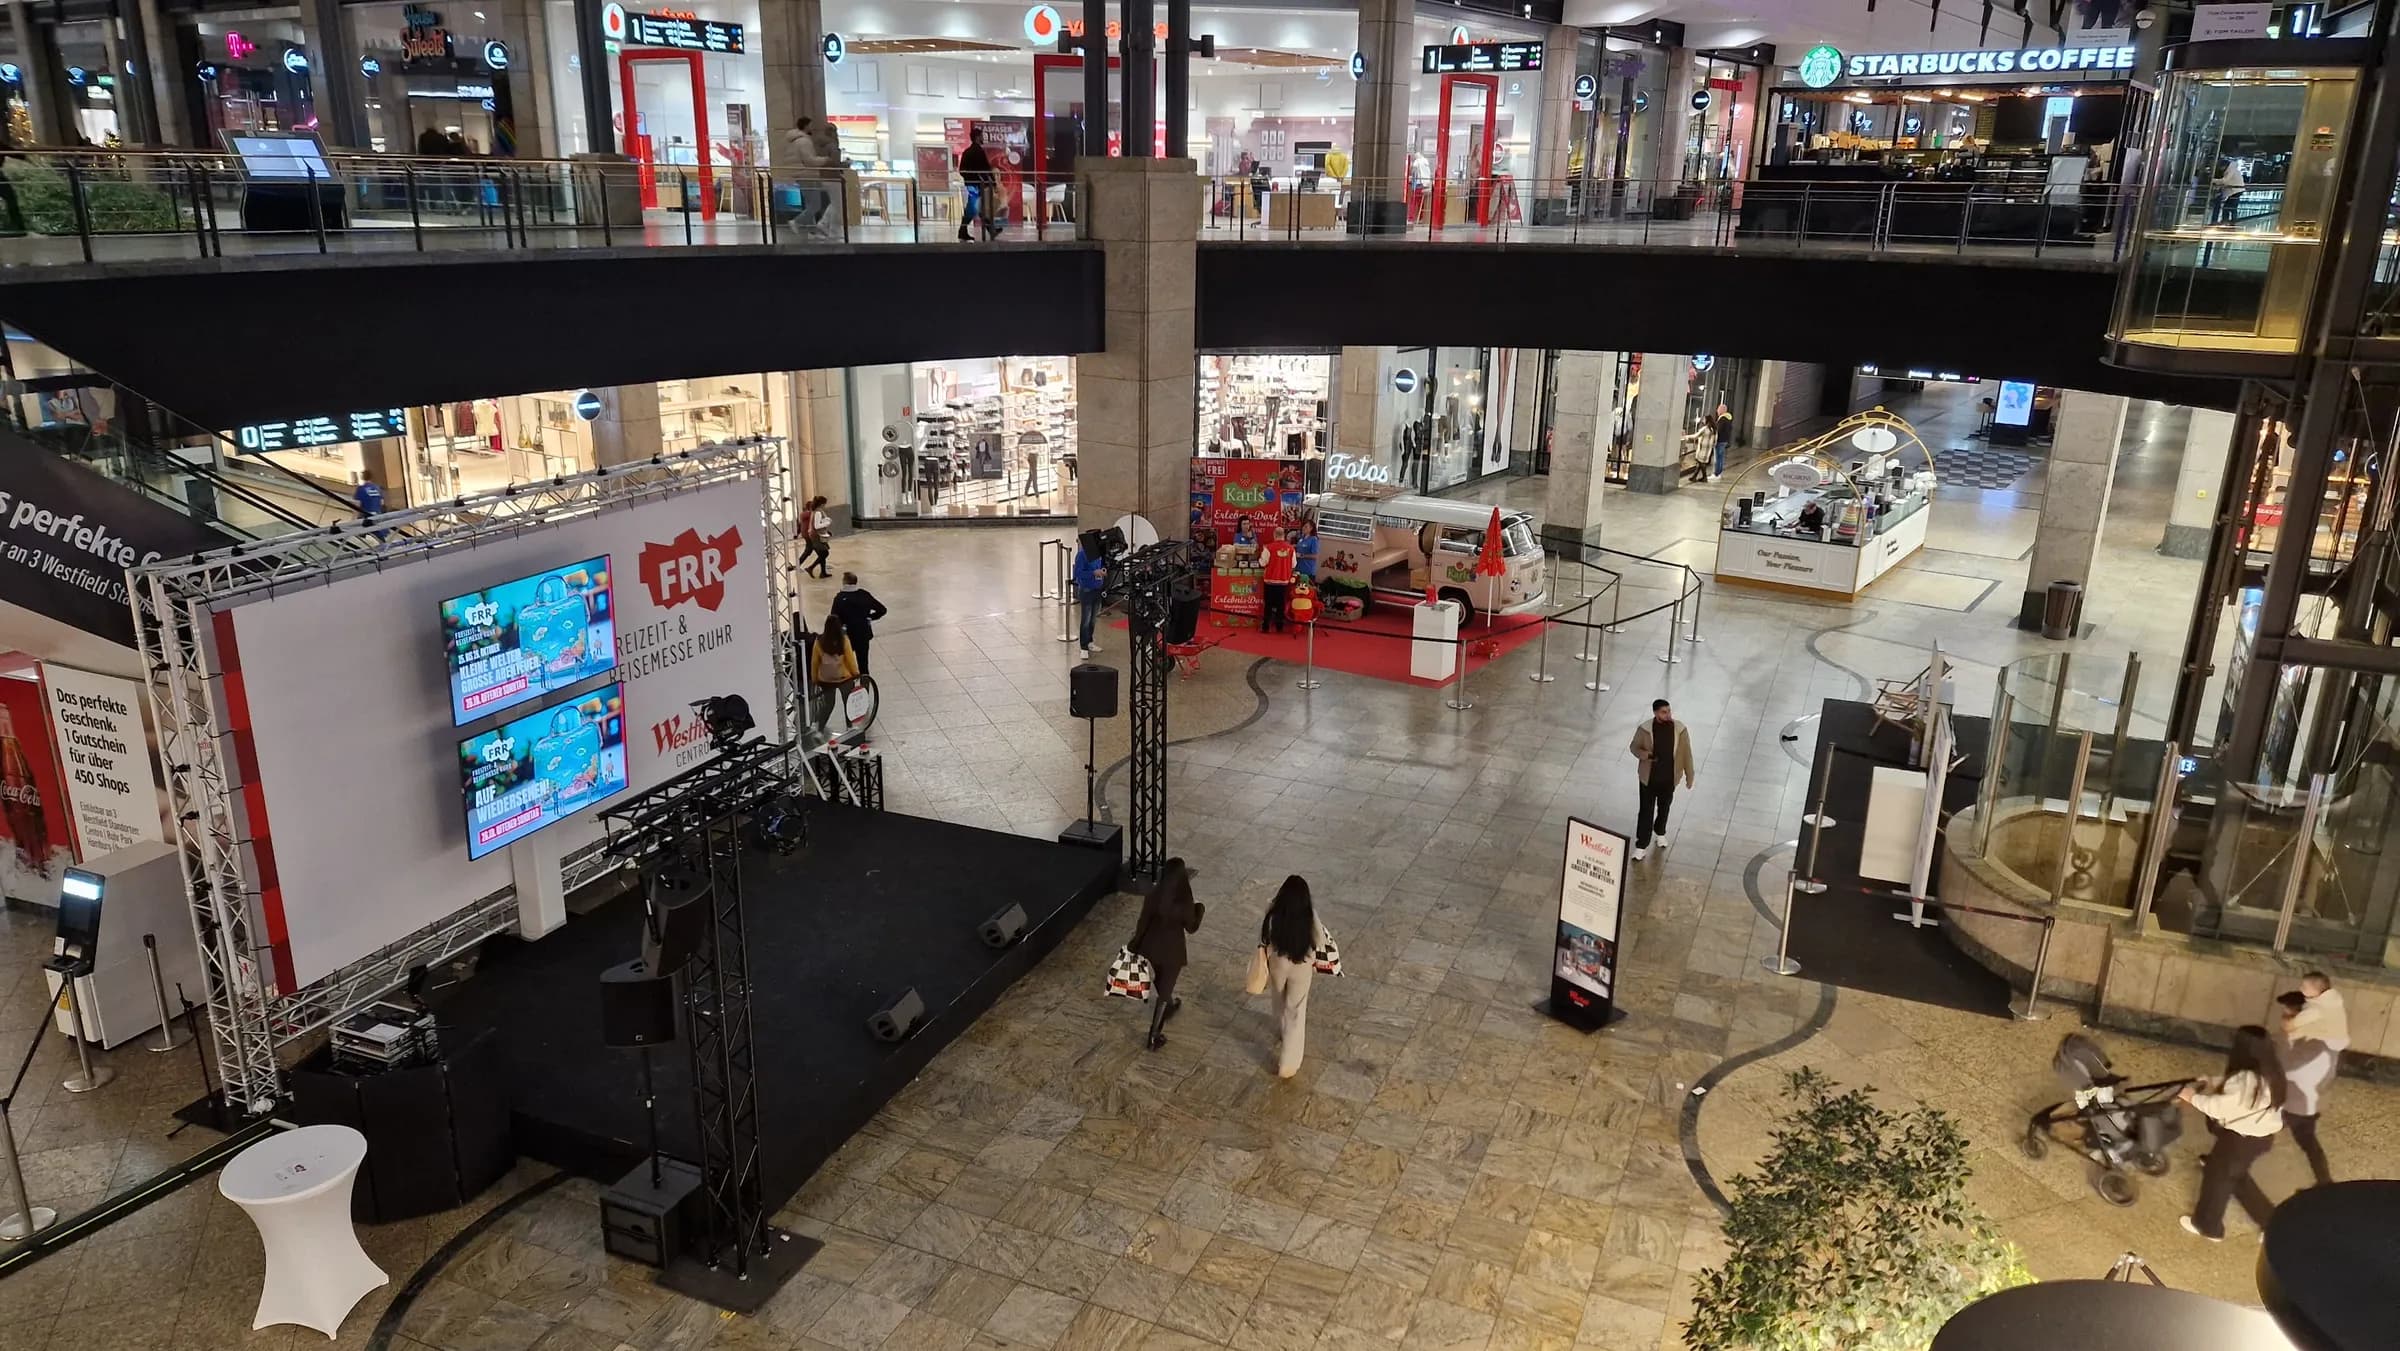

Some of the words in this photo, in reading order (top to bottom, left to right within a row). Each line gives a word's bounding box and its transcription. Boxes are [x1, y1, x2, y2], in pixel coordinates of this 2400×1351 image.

[632, 18, 641, 41] 1
[1429, 50, 1436, 70] 1
[1848, 51, 2015, 76] STARBUCKS
[2020, 46, 2136, 71] COFFEE
[241, 426, 259, 448] 0
[1207, 465, 1226, 476] FREI
[1328, 453, 1389, 484] Fotos
[1224, 487, 1265, 502] Karls
[9, 500, 136, 568] perfekte
[7, 545, 28, 564] an
[28, 549, 41, 569] 3
[41, 553, 110, 597] Westfield
[659, 547, 724, 601] FRR
[471, 608, 492, 622] FRR
[616, 620, 673, 657] REIZEIT-
[678, 614, 688, 635] &
[608, 638, 694, 684] REISEMESSE
[697, 624, 733, 654] RUHR
[459, 661, 489, 681] KLEINE
[461, 671, 494, 693] GROSSE
[56, 688, 78, 706] Das
[79, 694, 127, 716] perfekte
[61, 708, 117, 733] Geschenk:
[64, 728, 71, 743] 1
[71, 729, 127, 755] Gutschein
[651, 714, 712, 758] Westfi
[69, 747, 86, 764] für
[88, 751, 113, 771] über
[488, 743, 509, 760] FRR
[676, 741, 711, 768] CENTRO
[74, 768, 95, 786] 450
[97, 772, 130, 795] Shops
[475, 785, 496, 808] AUF
[476, 778, 550, 824] WIEDERSEHEN!
[82, 812, 108, 828] Westfield
